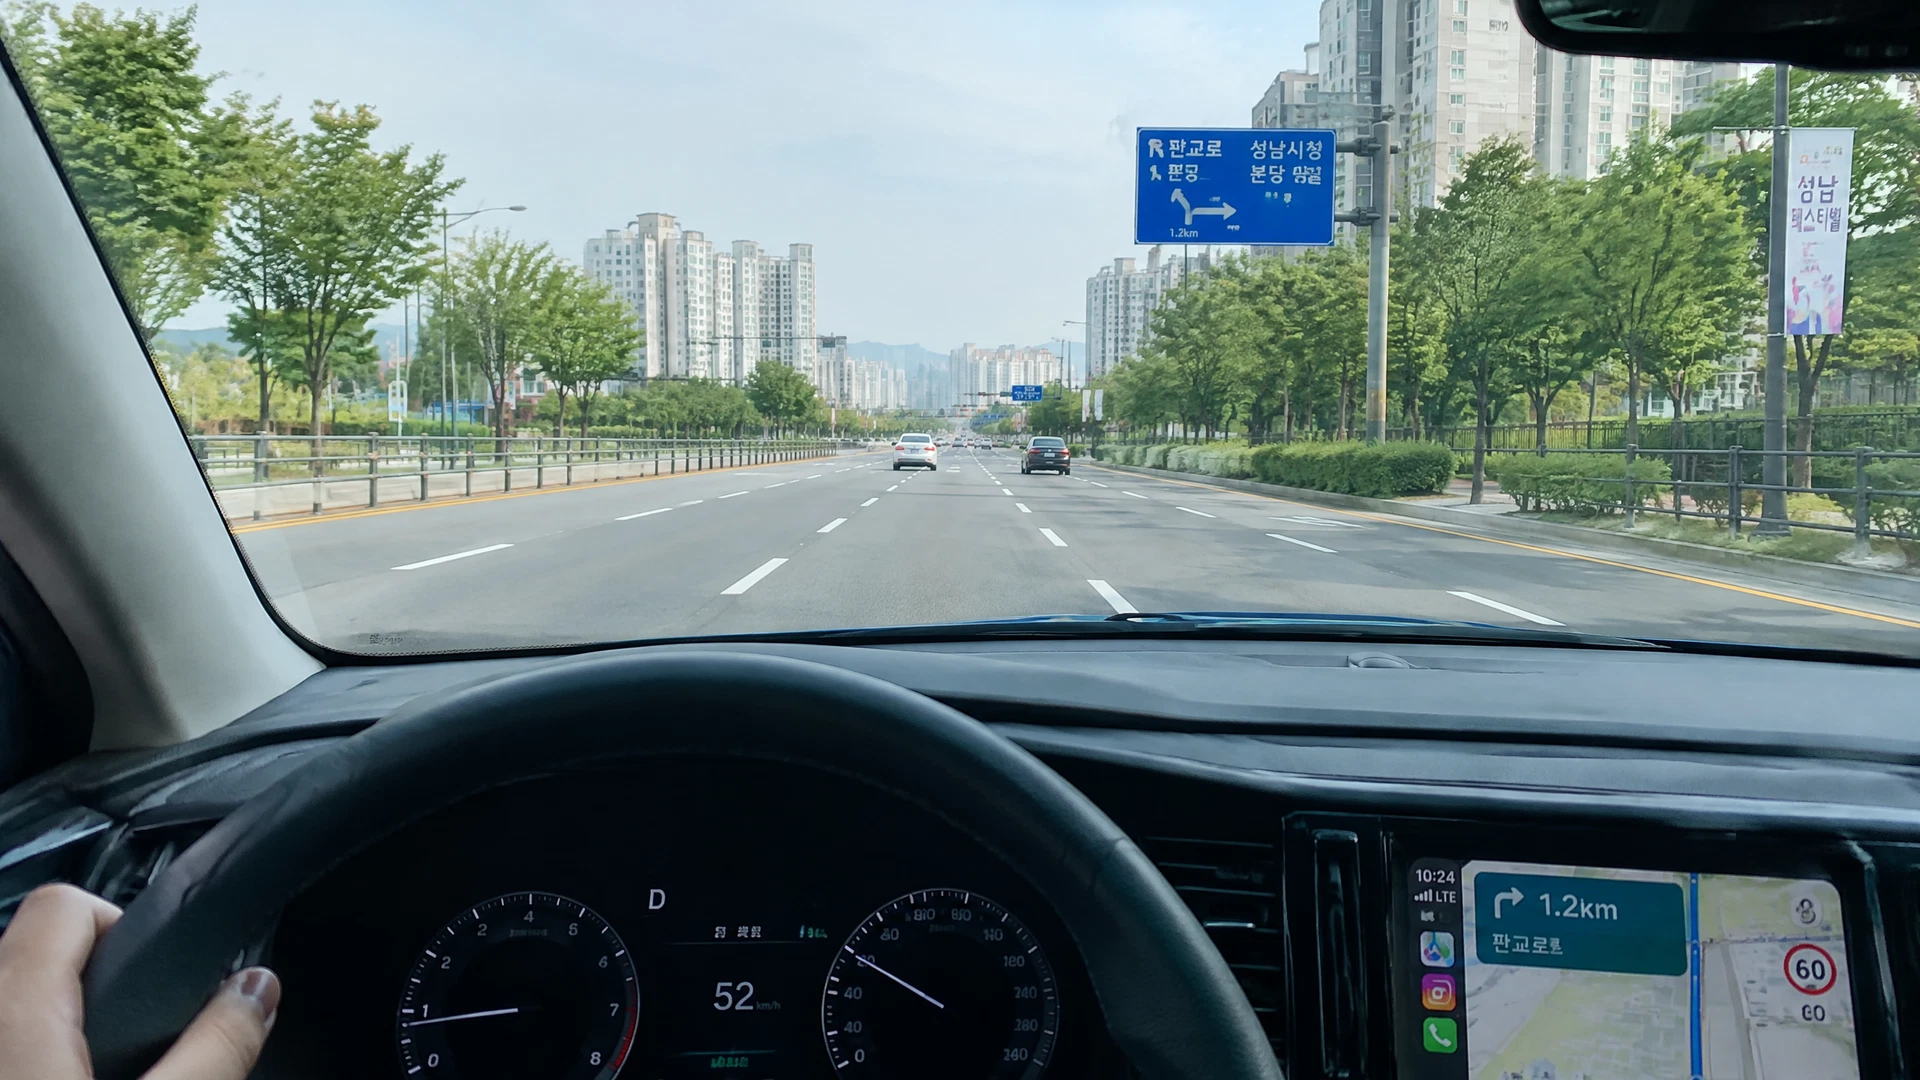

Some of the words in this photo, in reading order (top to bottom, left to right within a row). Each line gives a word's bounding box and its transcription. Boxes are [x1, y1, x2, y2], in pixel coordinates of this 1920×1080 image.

[1250, 140, 1323, 160] 성남시청
[1798, 175, 1838, 204] 성남
[1169, 228, 1199, 238] 1.2km
[1415, 869, 1456, 884] 10:24
[648, 888, 666, 910] D
[1435, 890, 1457, 904] LTE
[1539, 893, 1619, 921] 1.2km
[523, 910, 534, 923] 4
[477, 923, 488, 937] 2
[441, 956, 451, 969] 2
[599, 956, 608, 968] 6
[1796, 959, 1826, 980] 60
[713, 981, 754, 1011] 52
[756, 1001, 781, 1010] km/h
[422, 1004, 429, 1017] 1
[610, 1003, 619, 1017] 7
[427, 1053, 439, 1068] 0
[590, 1051, 601, 1066] 8
[854, 1049, 866, 1063] 0
